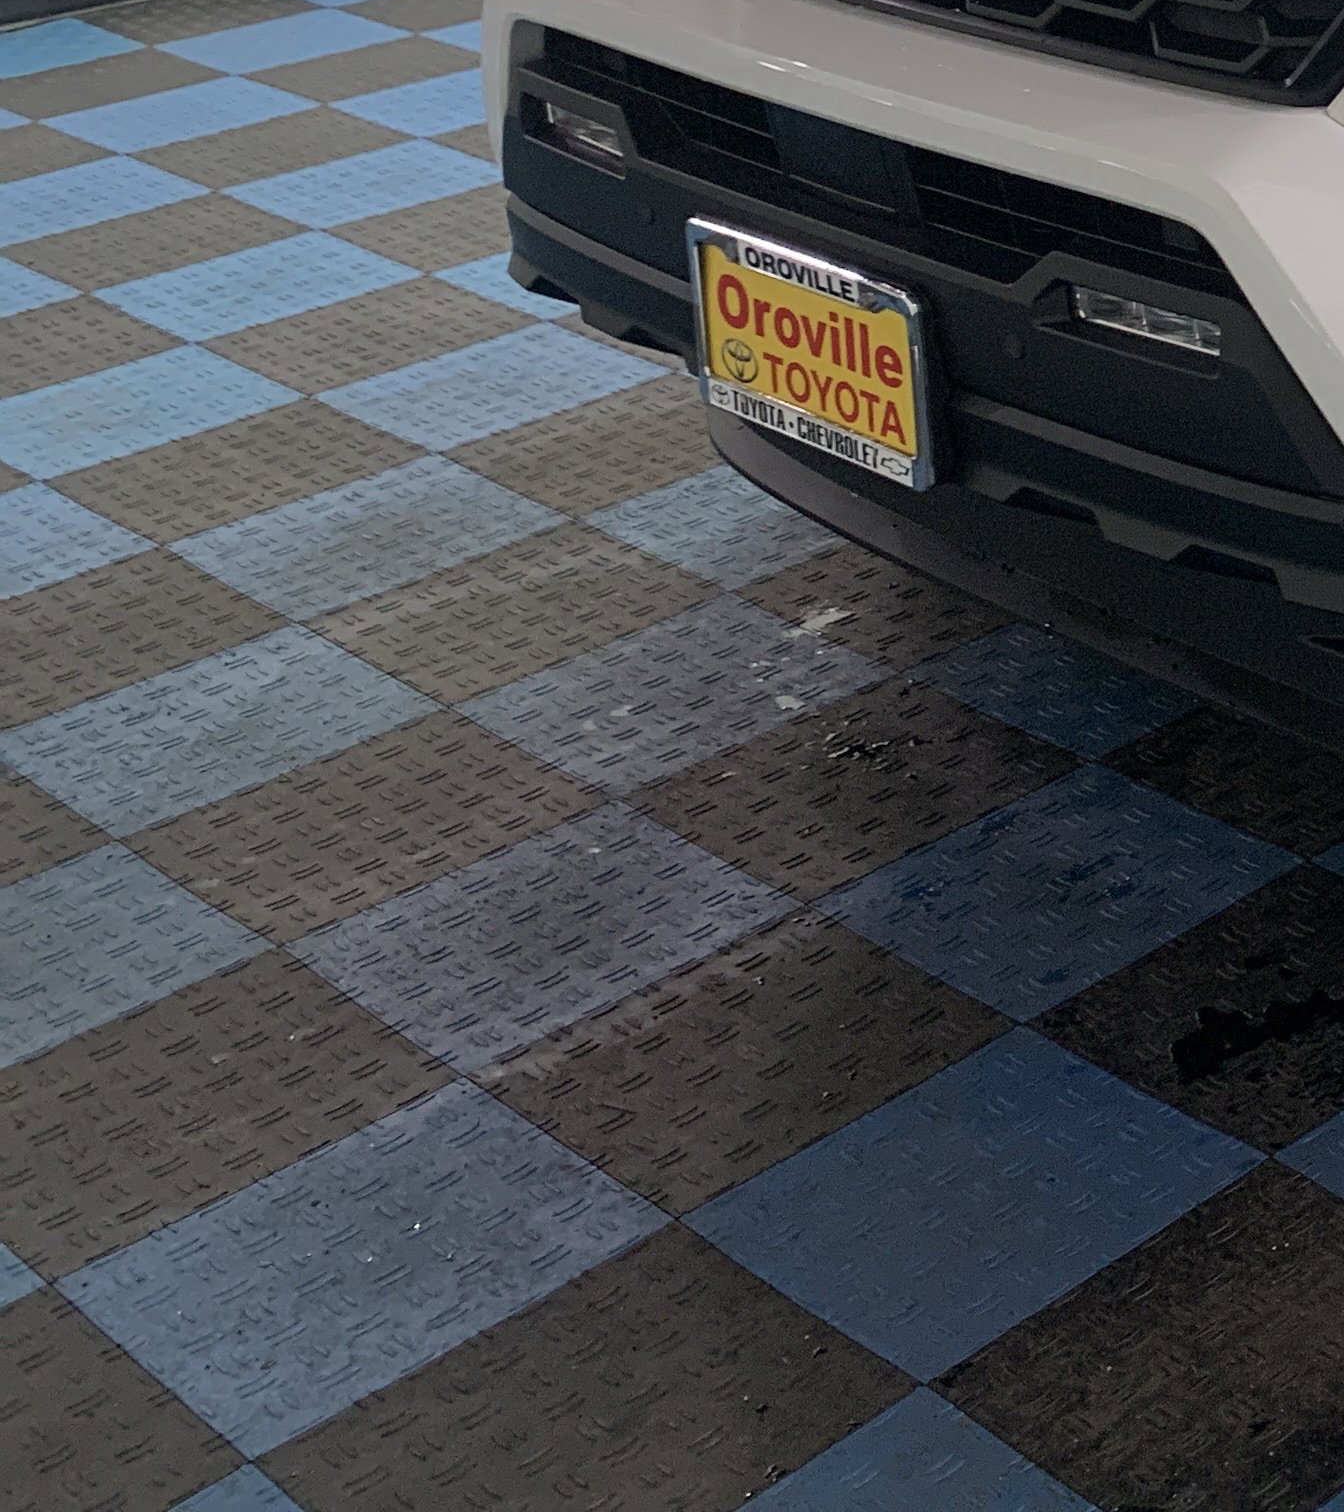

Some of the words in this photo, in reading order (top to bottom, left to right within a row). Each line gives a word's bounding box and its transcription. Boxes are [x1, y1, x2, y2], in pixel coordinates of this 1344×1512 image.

[745, 247, 856, 303] OROVILLE
[717, 273, 904, 388] Oroville
[731, 390, 786, 431] TOYOTA
[797, 417, 879, 469] CHEVROLET
[763, 352, 907, 446] TOYOTA
